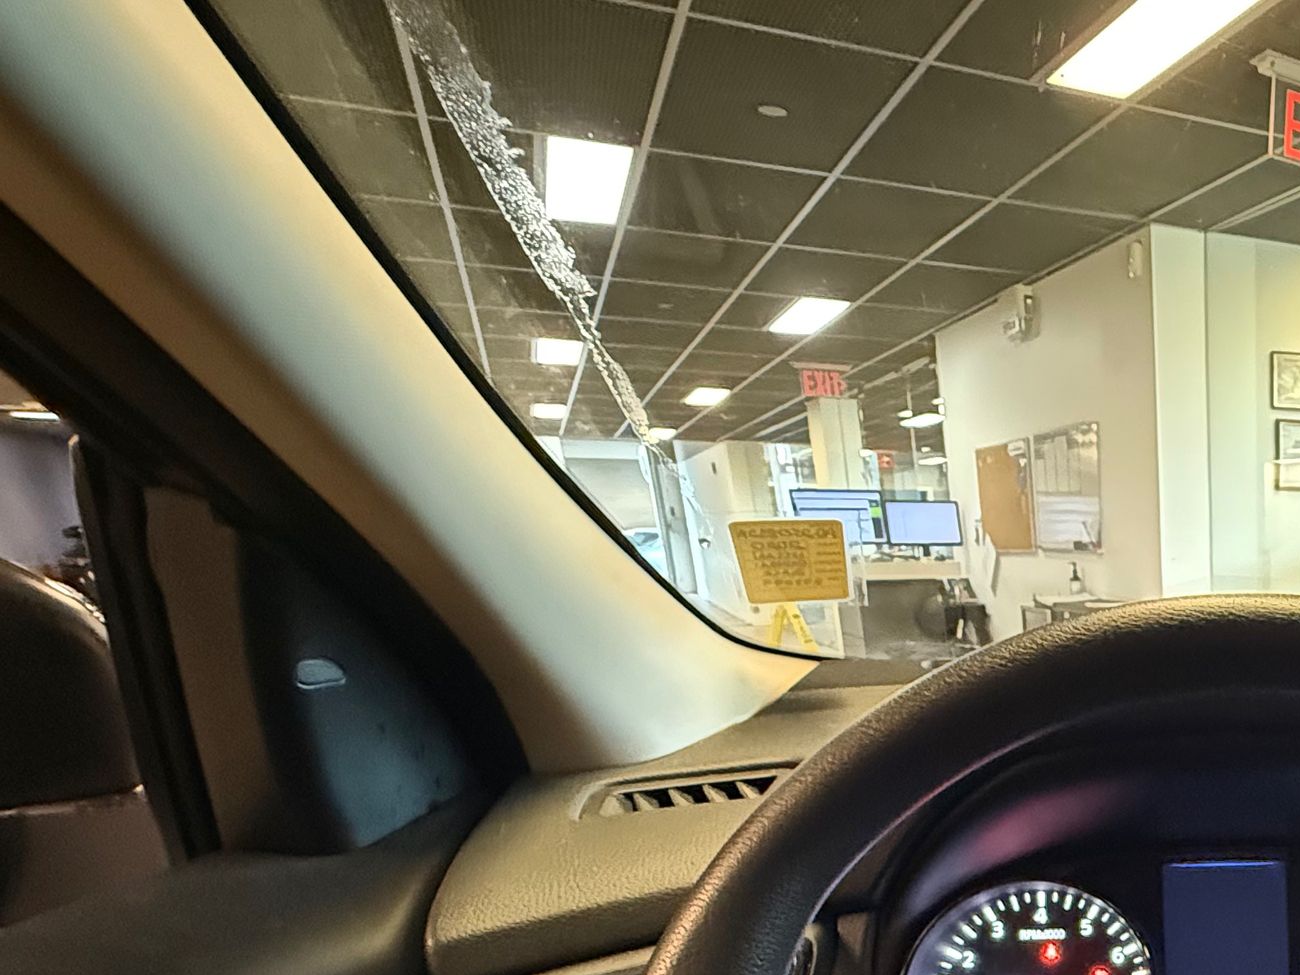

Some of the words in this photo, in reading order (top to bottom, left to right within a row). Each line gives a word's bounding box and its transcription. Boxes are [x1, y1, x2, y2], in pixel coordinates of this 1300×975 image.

[803, 369, 842, 397] EXIT
[1032, 908, 1048, 925] 4
[990, 921, 1004, 939] 3
[1080, 919, 1094, 937] 5
[962, 950, 976, 969] 2
[1111, 946, 1125, 965] 6
